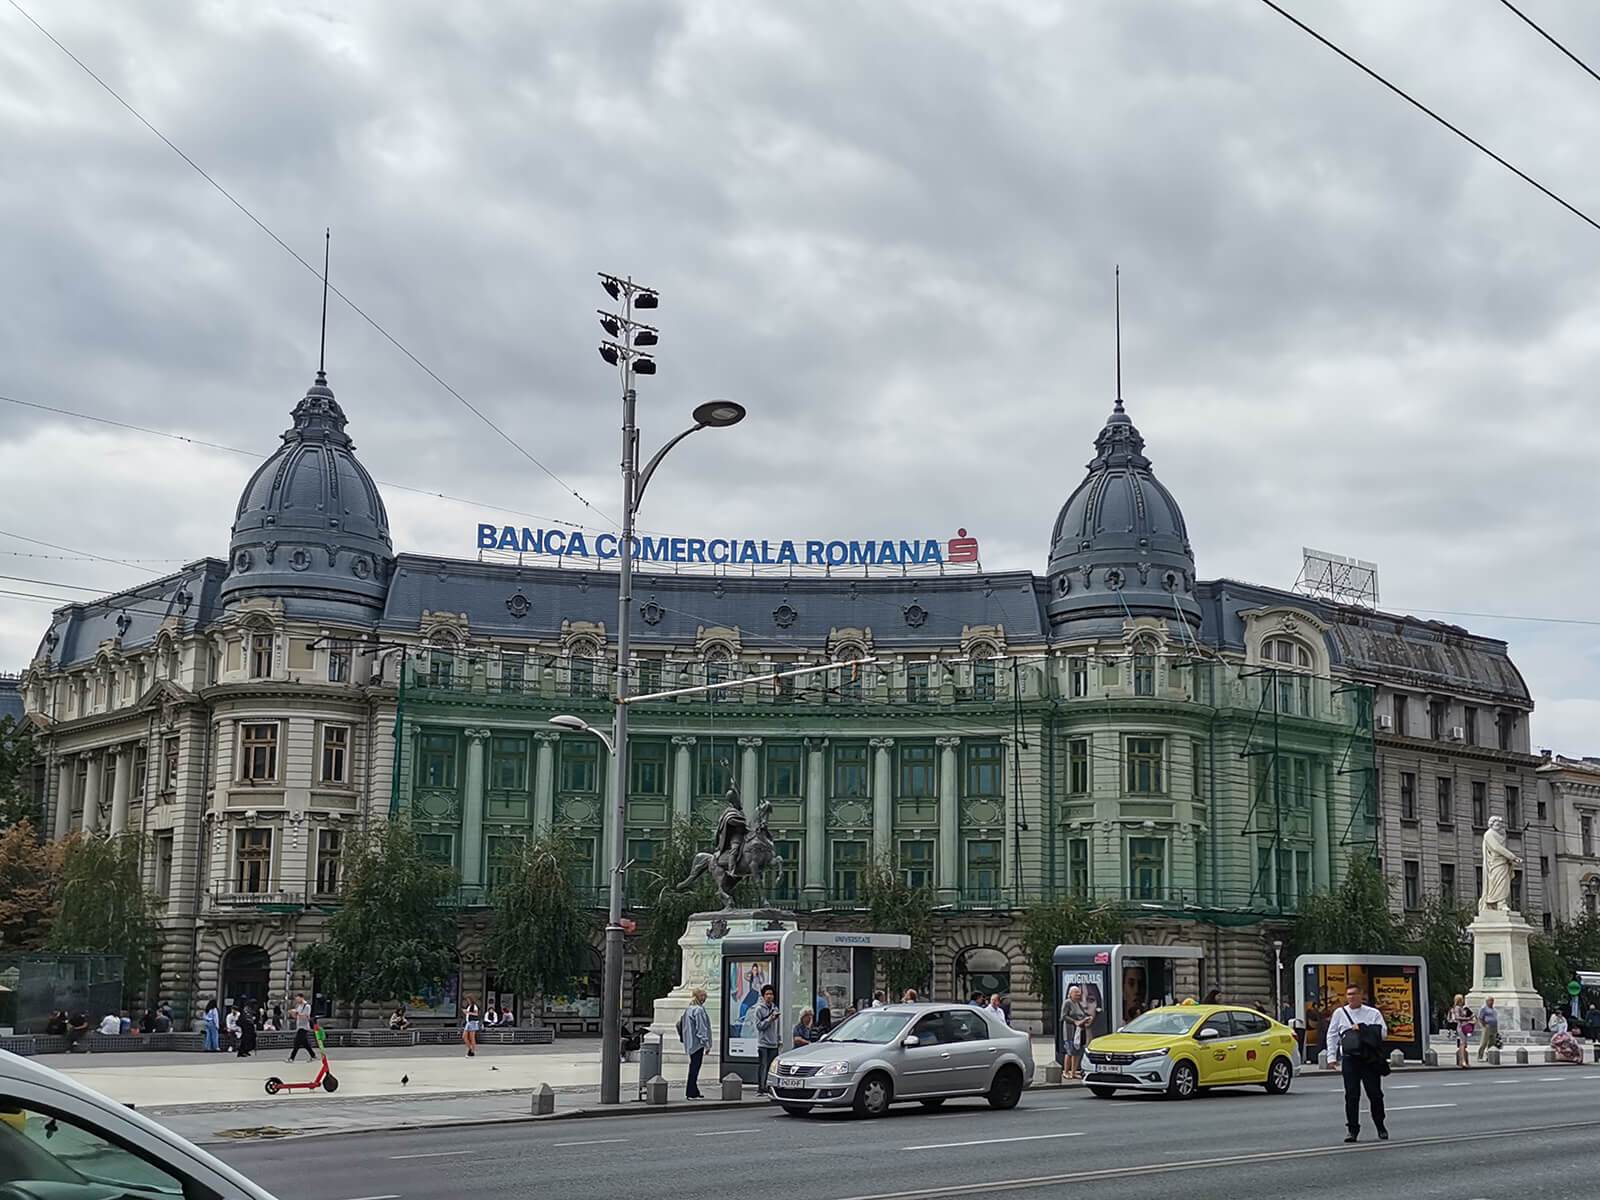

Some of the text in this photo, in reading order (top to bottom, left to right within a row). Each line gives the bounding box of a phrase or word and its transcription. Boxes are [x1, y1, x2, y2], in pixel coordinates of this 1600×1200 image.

[478, 523, 943, 566] BANCA COMERCIALA ROMANA
[1063, 973, 1102, 985] ORIGINALS
[1377, 986, 1409, 996] McCrispy
